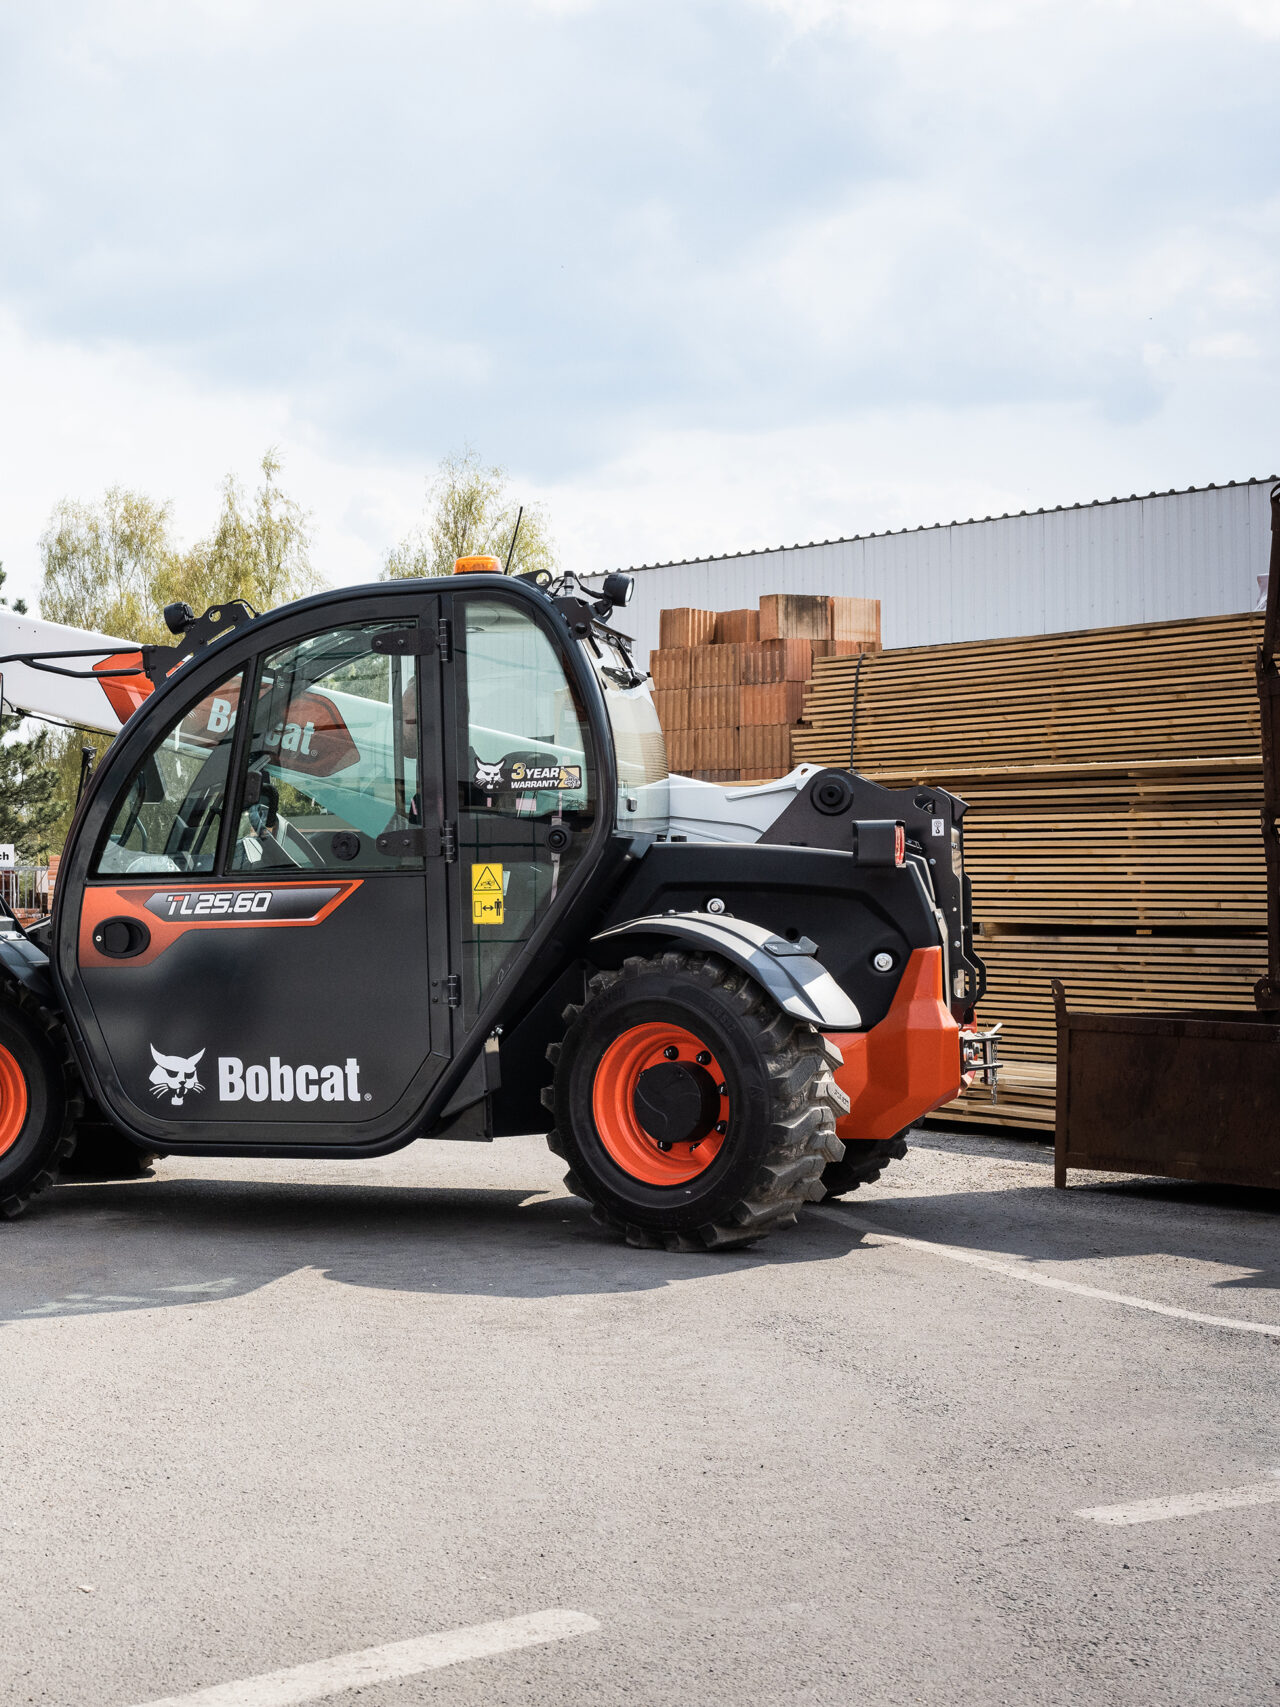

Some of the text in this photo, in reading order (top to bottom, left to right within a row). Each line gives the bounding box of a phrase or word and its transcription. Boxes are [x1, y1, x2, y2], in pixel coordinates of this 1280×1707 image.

[511, 762, 560, 779] 3 YEAR
[511, 779, 560, 789] WARRANTY
[168, 892, 272, 915] TL25.60
[218, 1056, 361, 1102] Bobcat
